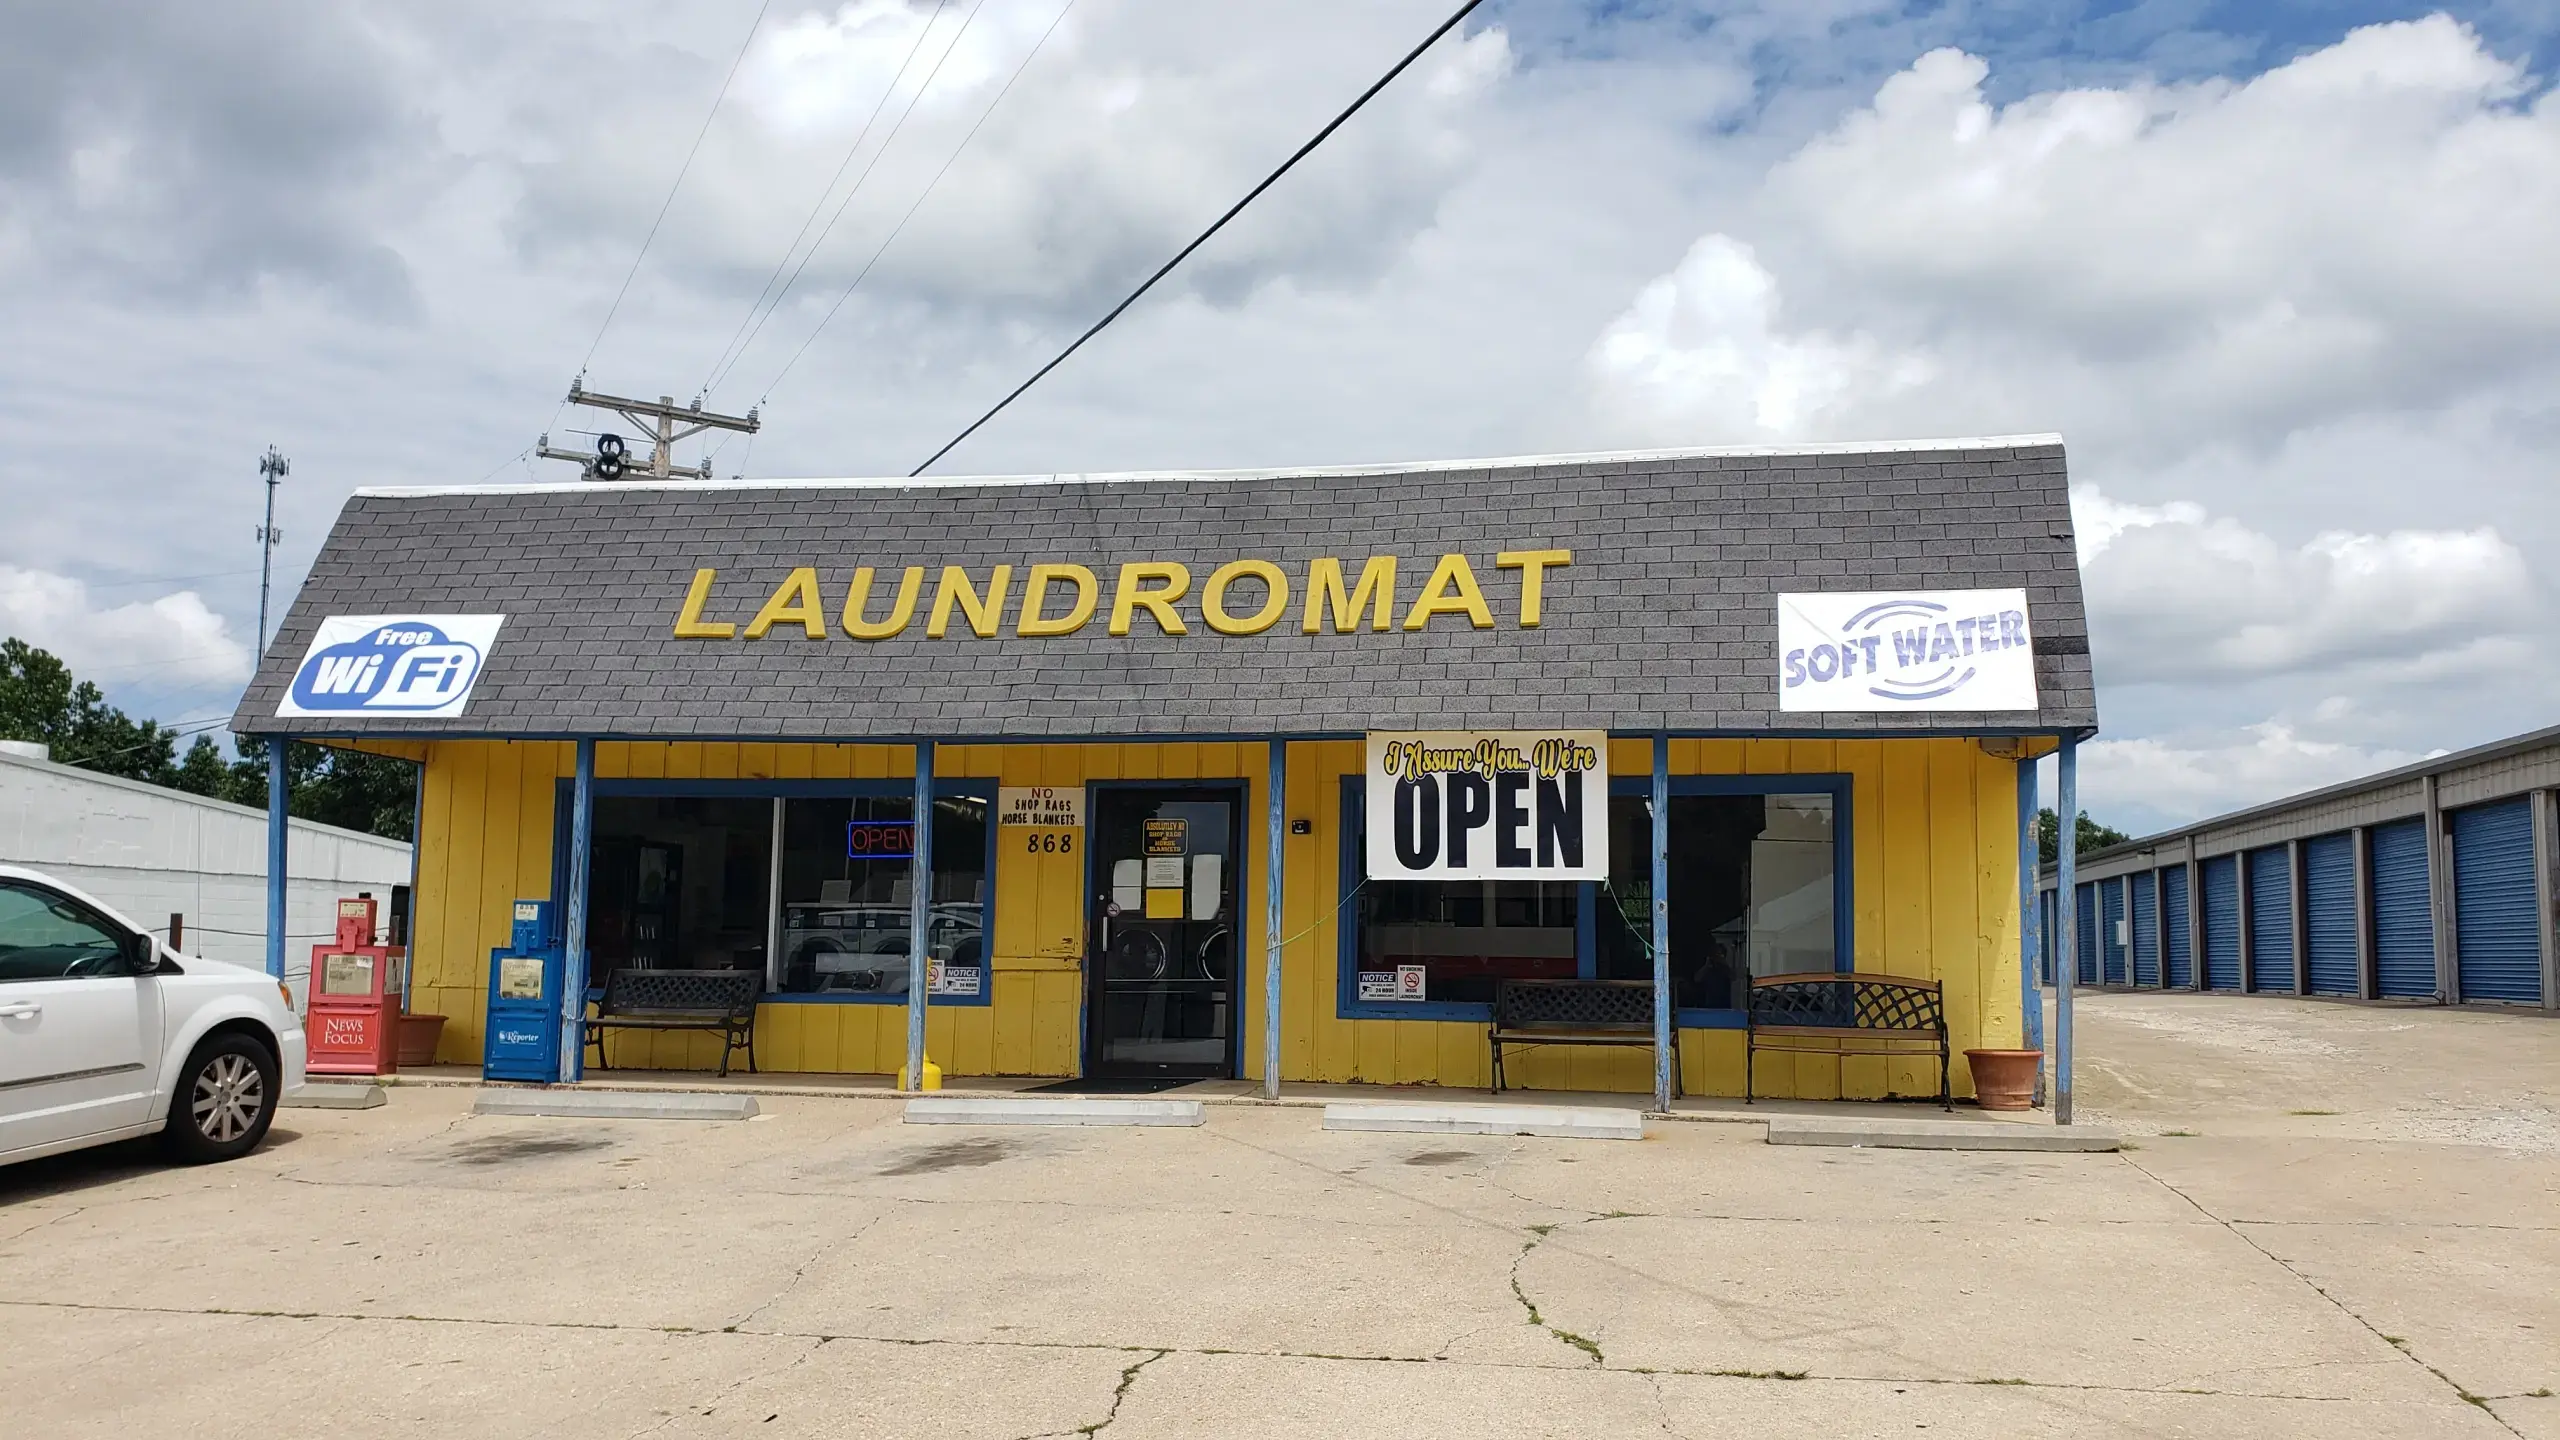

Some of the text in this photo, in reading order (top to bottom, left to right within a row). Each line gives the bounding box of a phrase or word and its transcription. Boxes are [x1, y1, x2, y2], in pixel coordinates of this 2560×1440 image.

[673, 549, 1571, 640] LAUNDROMAT
[374, 629, 434, 646] Free
[1785, 610, 2027, 688] SOFT WATER
[1404, 740, 1475, 783] Assure
[1032, 788, 1053, 799] NO
[1015, 799, 1072, 812] SHOP RAGS
[1002, 813, 1076, 826] HORSE BLANKETS
[1394, 770, 1584, 871] OPEN
[852, 827, 915, 851] OPEN
[1027, 833, 1072, 854] 868
[947, 969, 978, 977] NOTICE
[1362, 974, 1394, 982] NOTICE
[327, 1018, 363, 1031] NEWS
[325, 1031, 364, 1045] FOCUS
[505, 1031, 539, 1044] Reporter
